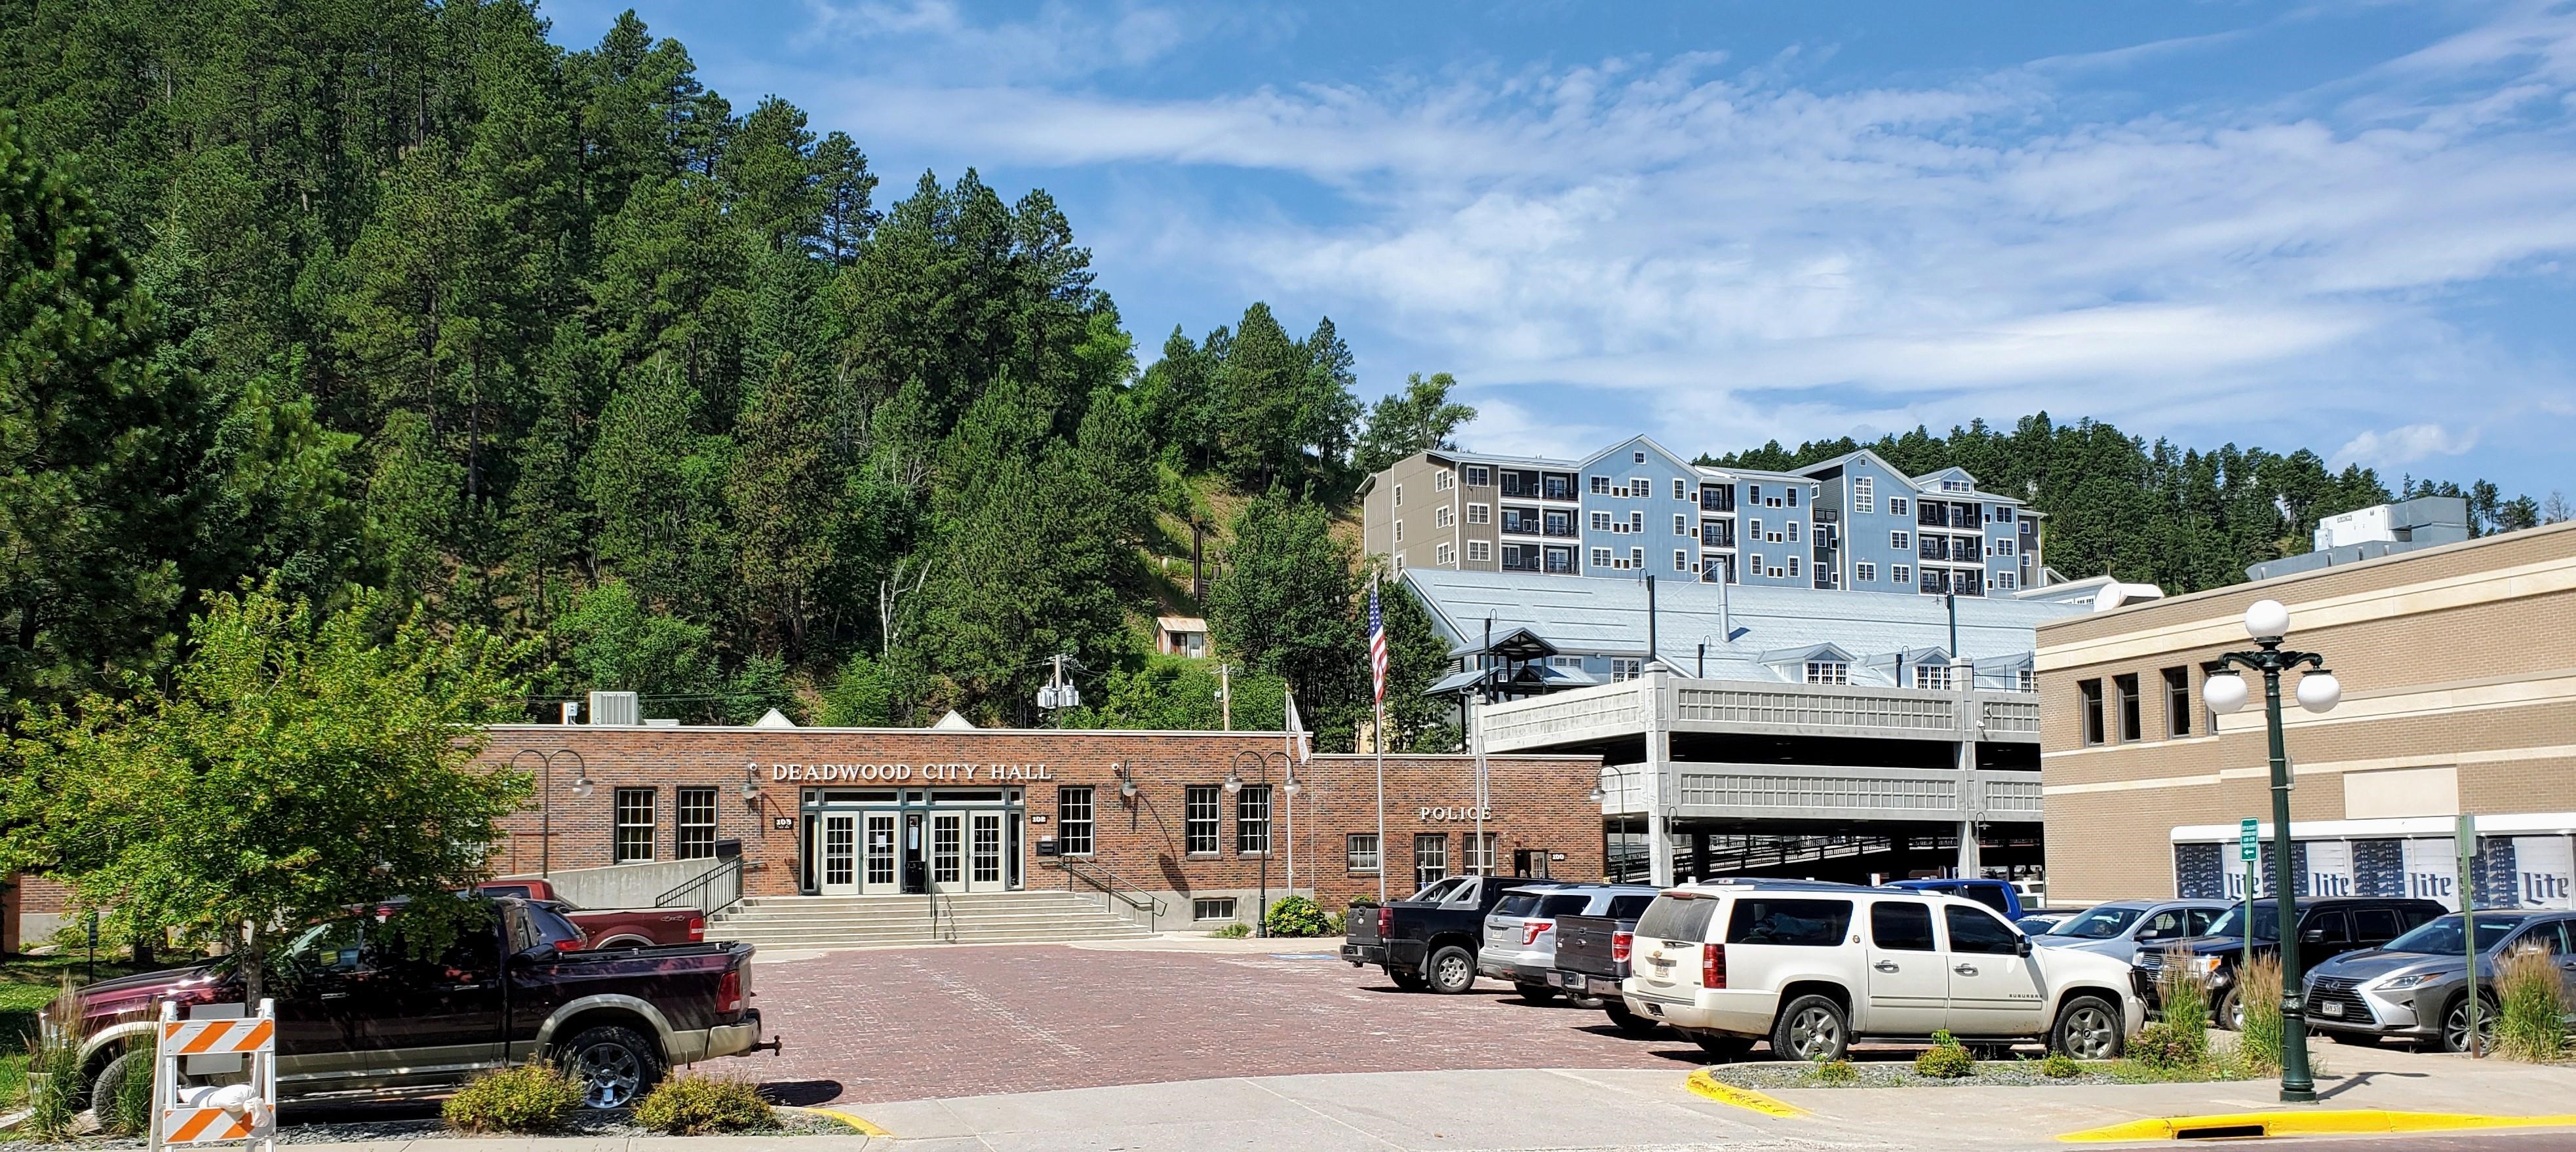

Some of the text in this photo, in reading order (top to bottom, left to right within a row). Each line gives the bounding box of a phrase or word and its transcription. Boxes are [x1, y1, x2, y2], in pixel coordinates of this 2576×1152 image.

[772, 764, 1053, 780] DEADWOOD CITY HALL
[1420, 807, 1492, 820] POLICE
[2521, 872, 2569, 905] Lite
